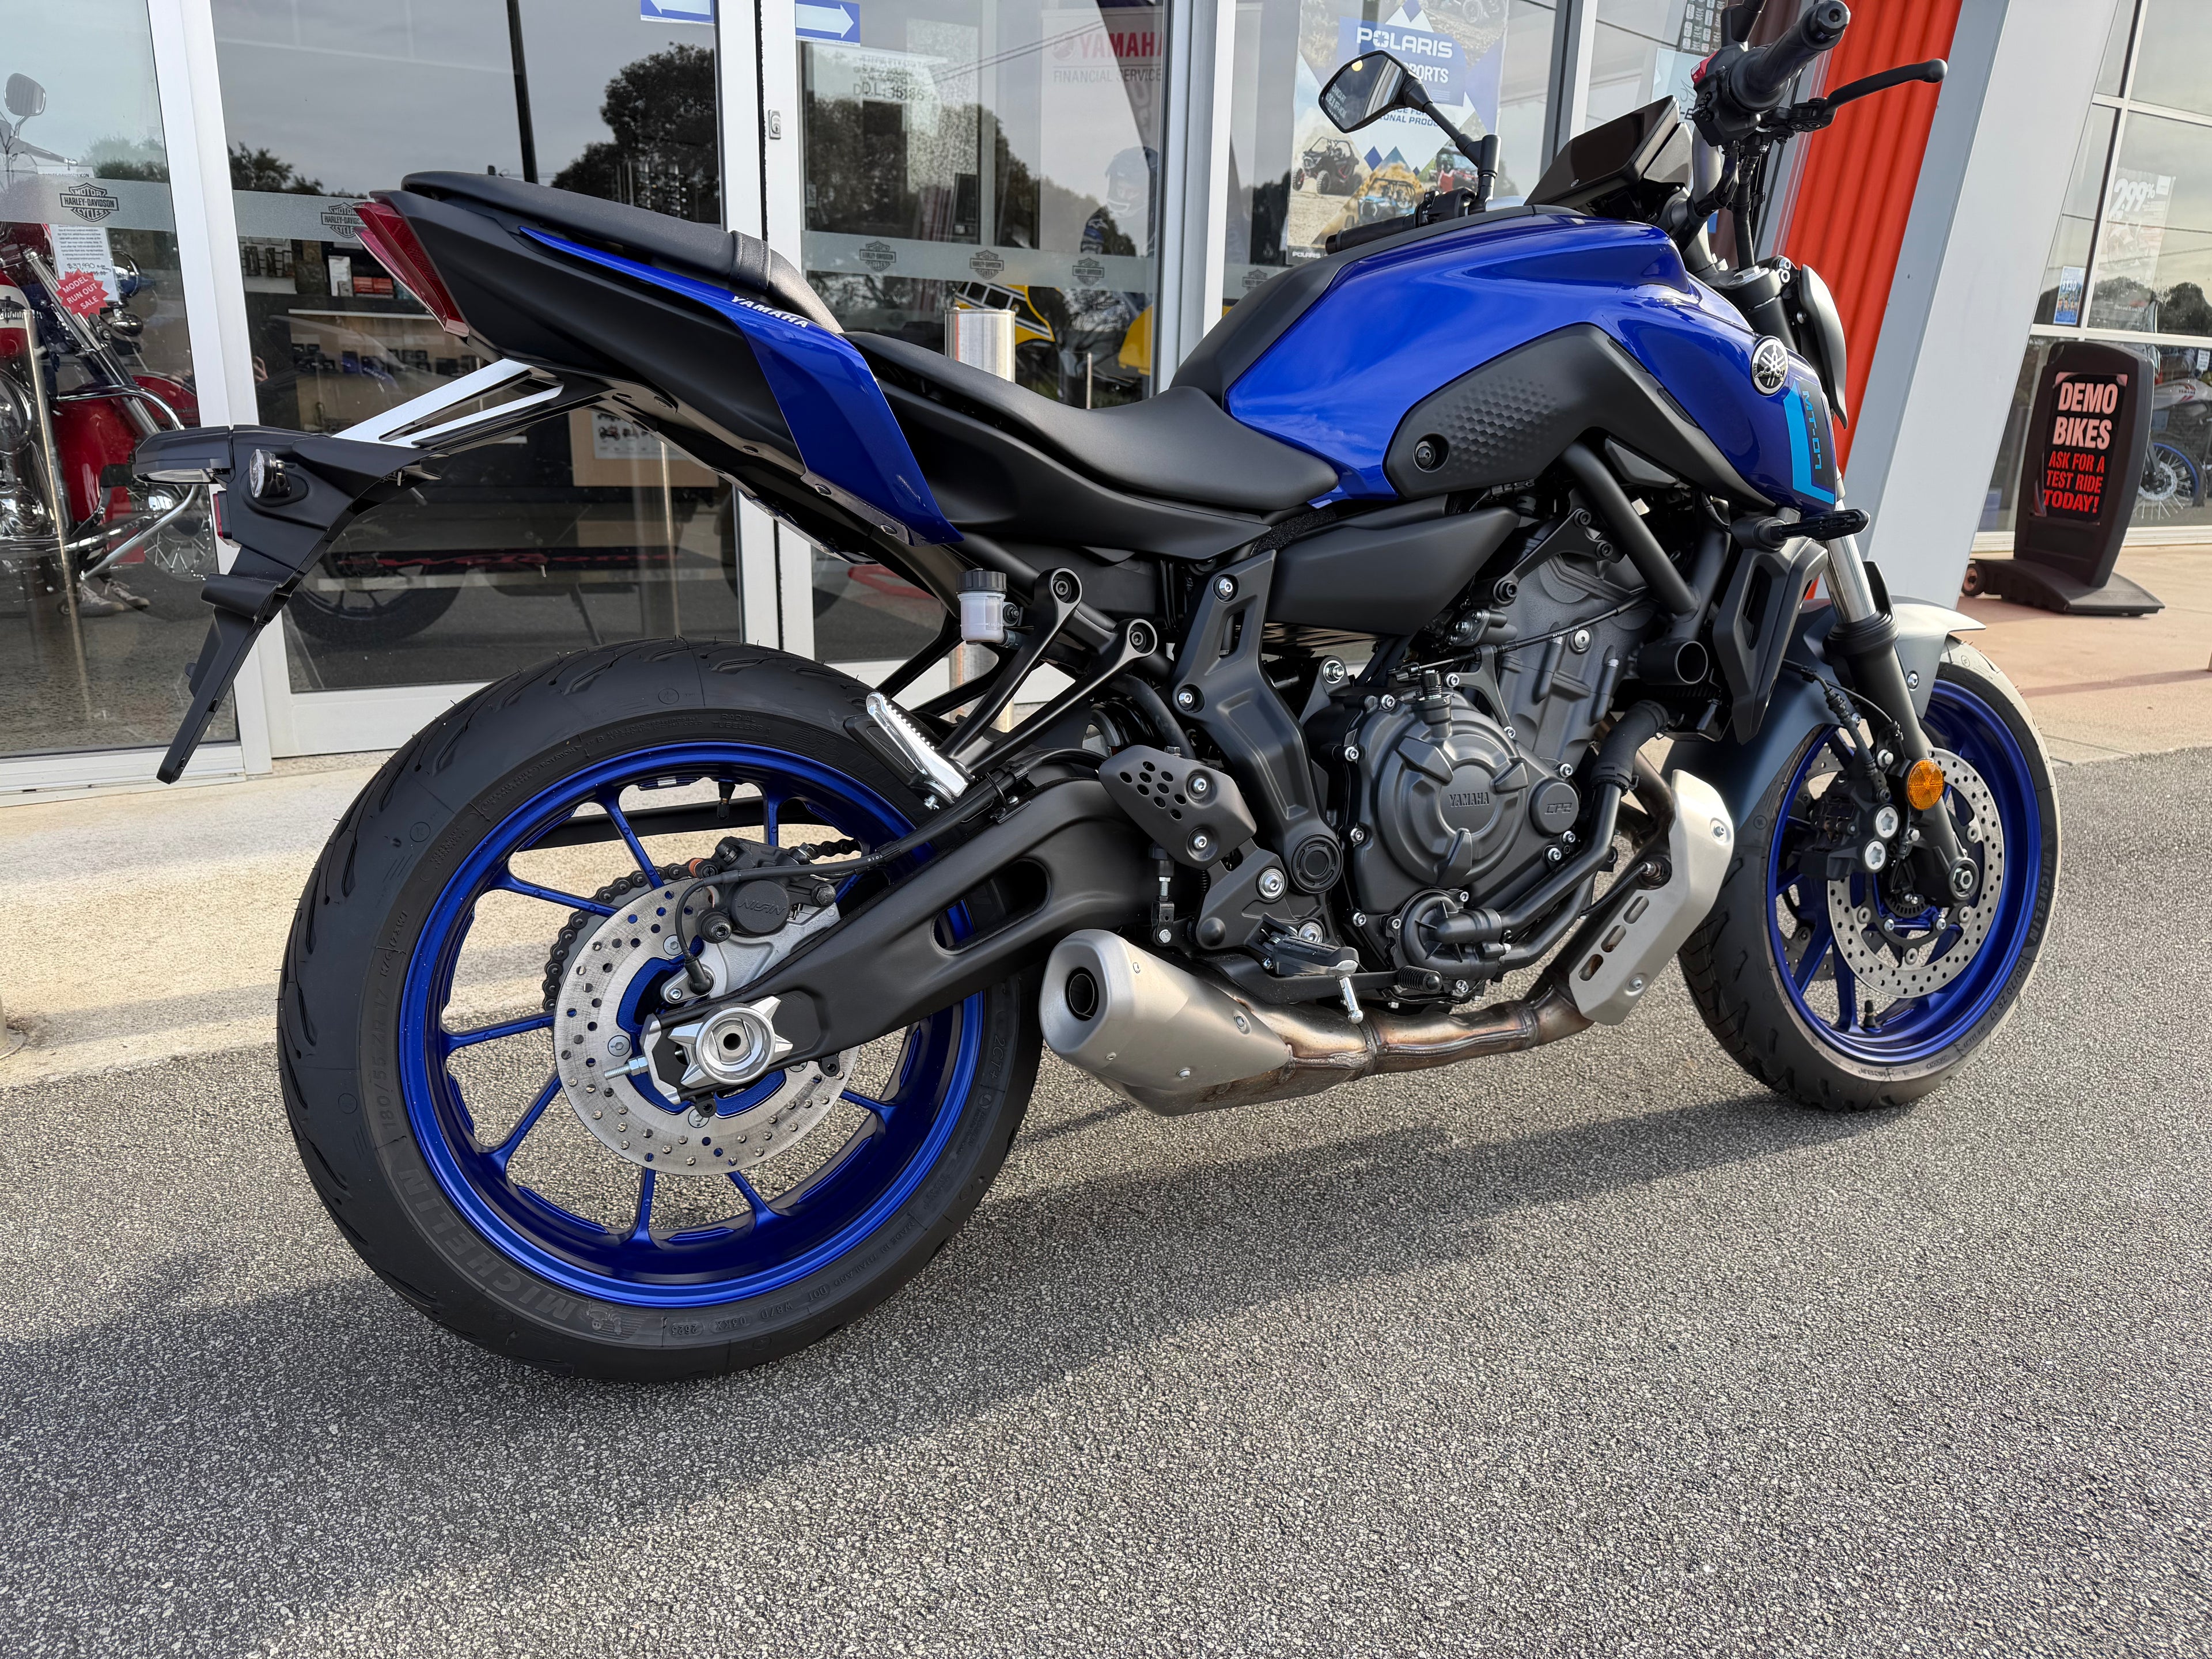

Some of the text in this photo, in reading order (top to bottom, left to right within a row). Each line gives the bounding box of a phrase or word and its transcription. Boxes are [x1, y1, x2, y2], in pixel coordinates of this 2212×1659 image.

[1357, 26, 1453, 58] POLARIS
[1054, 69, 1112, 84] FINANCIAL
[64, 197, 115, 208] HARLEY-DAVIDSON
[74, 187, 102, 196] MOTOR
[77, 208, 105, 219] CYCLES
[62, 276, 89, 294] MODEL
[66, 282, 98, 305] RUN OUT
[79, 296, 99, 310] SALE
[732, 296, 808, 328] YAMAHA
[2058, 382, 2118, 415] DEMO
[1802, 391, 1822, 469] MT-07
[2052, 416, 2112, 450] BIKES
[2048, 450, 2105, 474] ASK FOR A
[2046, 469, 2103, 494] TEST RIDE
[2043, 489, 2100, 514] TODAY!
[1449, 791, 1490, 806] YAMAHA
[2029, 852, 2052, 942] MICHELIN
[1990, 960, 2027, 1021] 120/70 ZR 17
[371, 1056, 397, 1131] 180/55
[397, 1165, 578, 1323] MICHELIN
[806, 1284, 829, 1302] DOT
